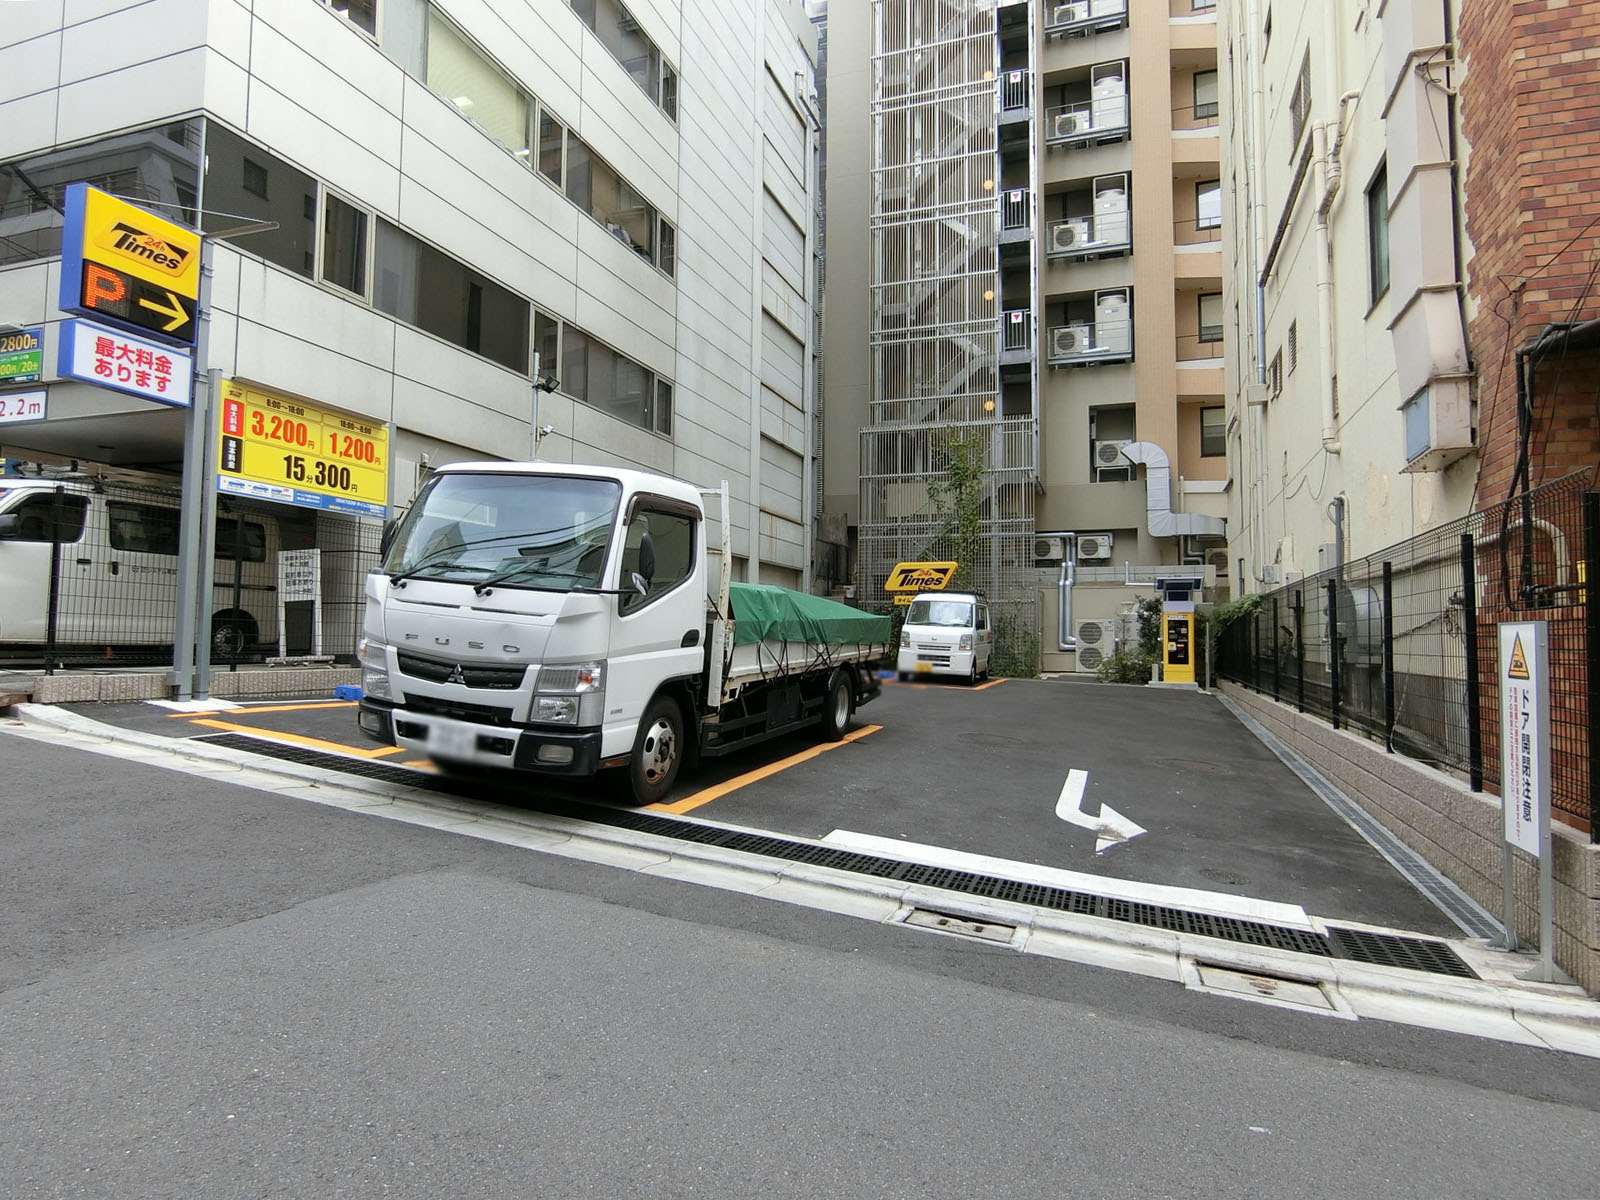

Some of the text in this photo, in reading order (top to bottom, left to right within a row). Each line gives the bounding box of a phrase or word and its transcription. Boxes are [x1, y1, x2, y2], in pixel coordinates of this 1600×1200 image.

[111, 225, 187, 270] Times
[85, 264, 127, 308] P
[0, 333, 38, 353] 2800円
[94, 336, 173, 376] 最大料金
[94, 358, 172, 393] あります
[251, 410, 315, 450] 3,200円
[330, 431, 381, 466] 1,200円
[898, 570, 946, 587] Times
[405, 633, 520, 653] FUSO
